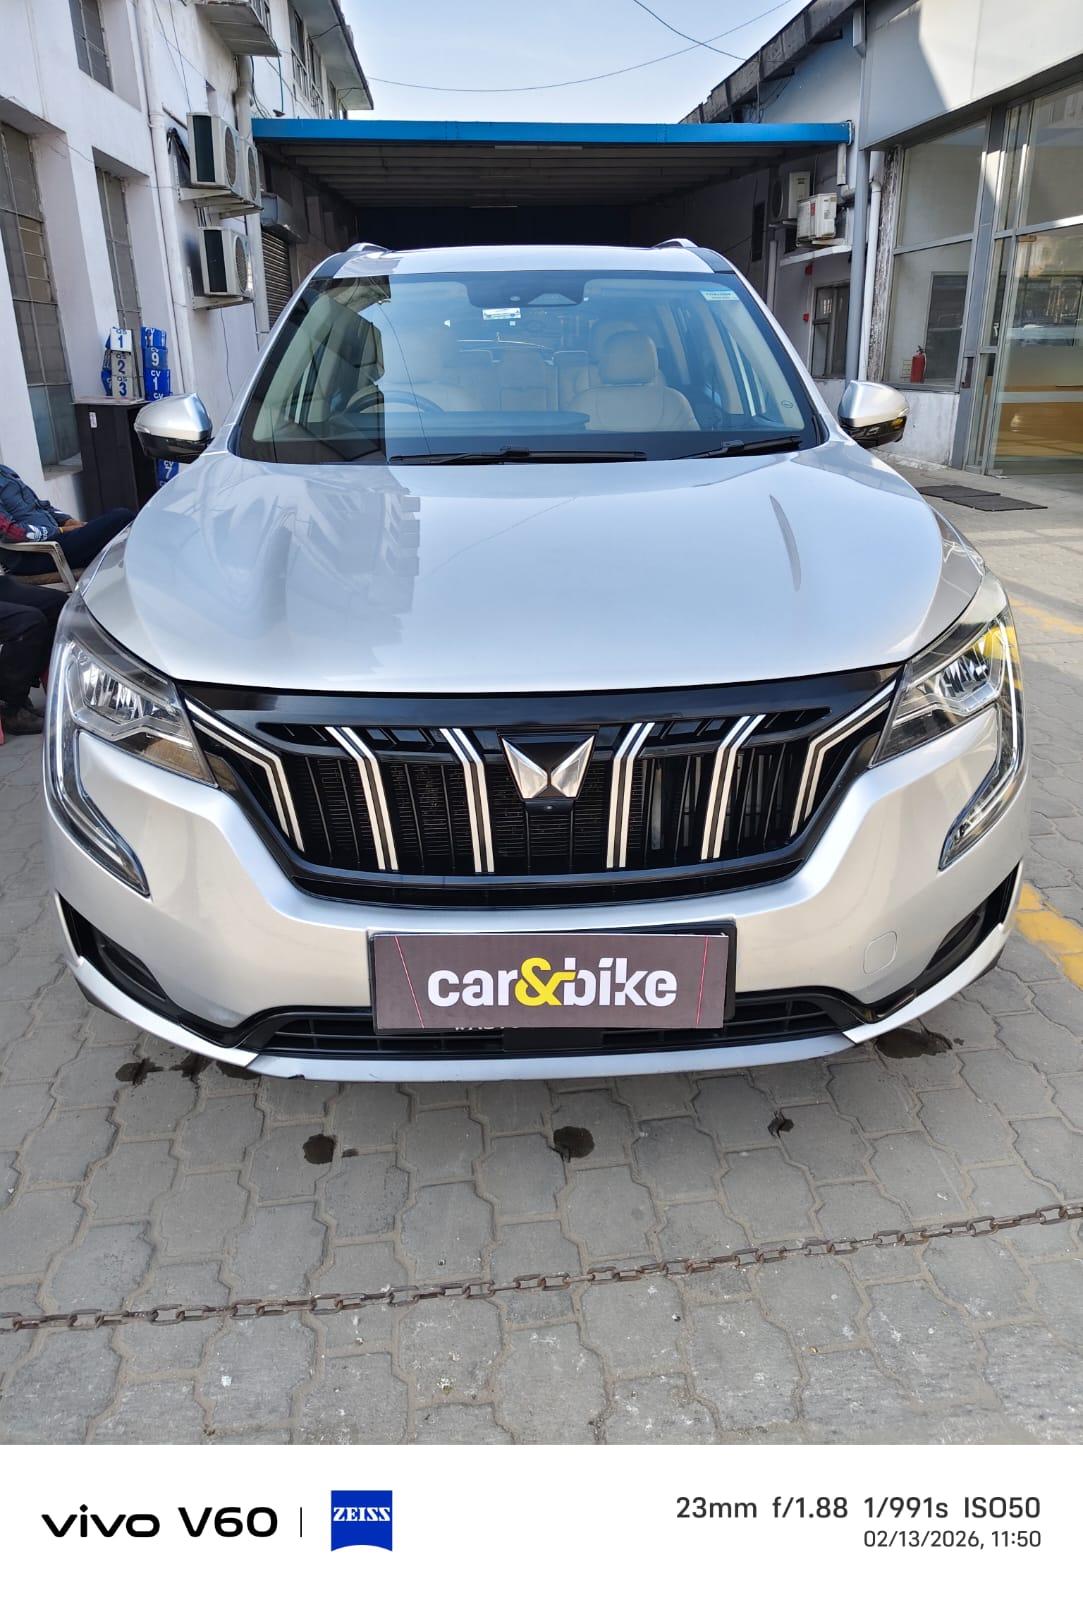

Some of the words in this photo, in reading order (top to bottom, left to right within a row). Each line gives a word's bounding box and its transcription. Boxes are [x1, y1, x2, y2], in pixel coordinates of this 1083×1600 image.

[118, 335, 123, 349] 1
[152, 352, 160, 367] 9
[118, 360, 126, 374] 2
[119, 382, 127, 396] 3
[153, 377, 158, 391] 1
[427, 956, 678, 1008] car&bike
